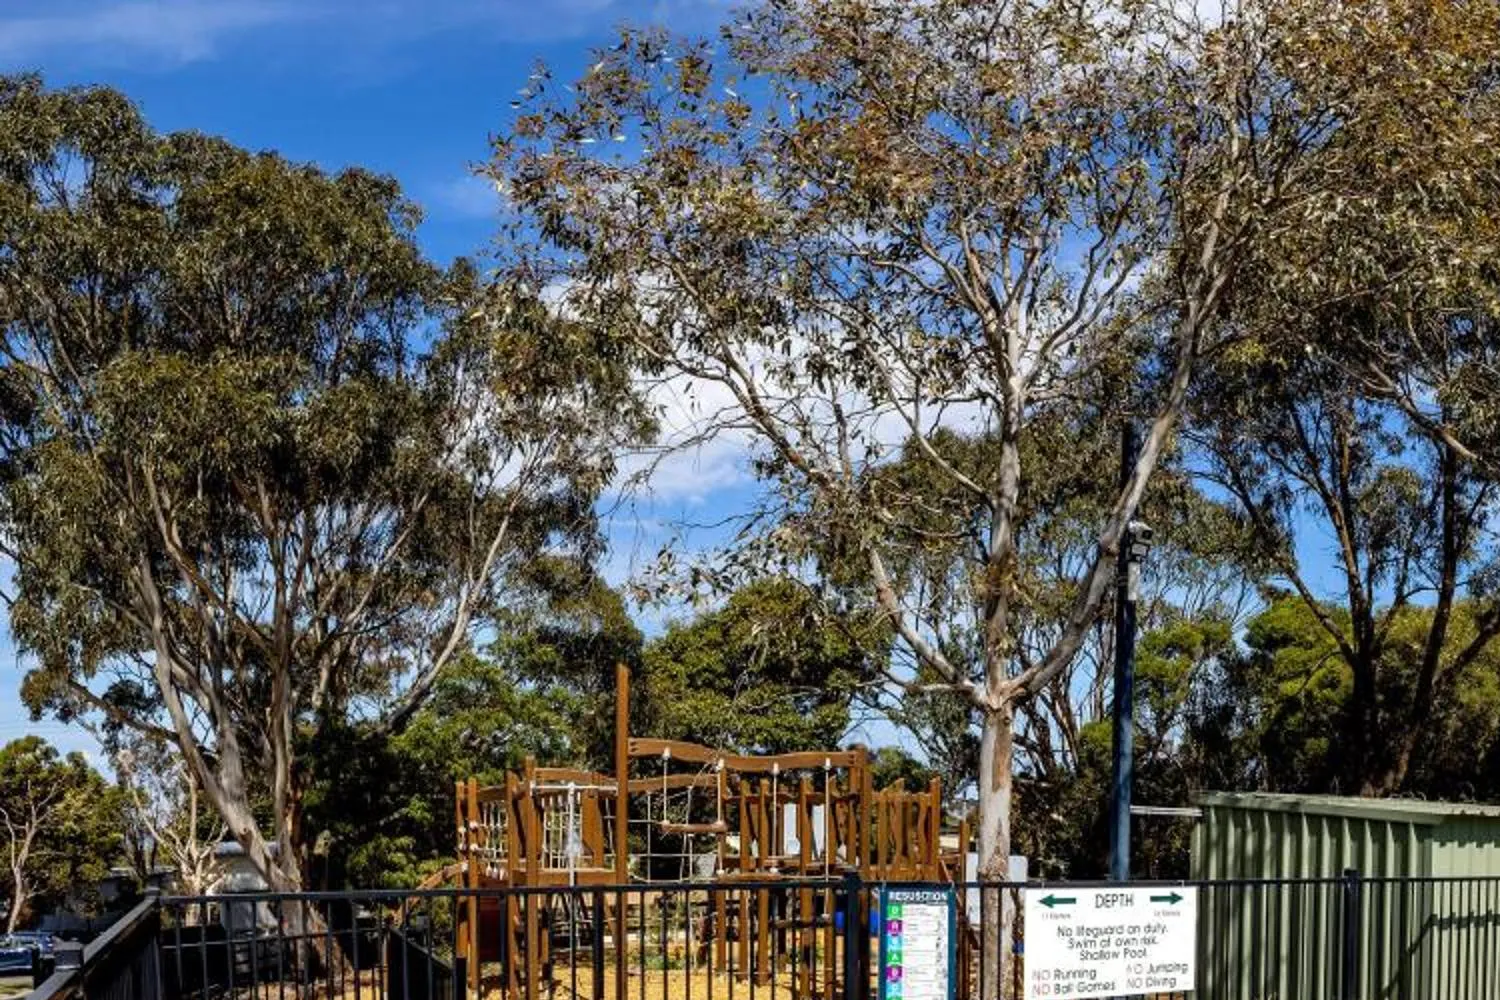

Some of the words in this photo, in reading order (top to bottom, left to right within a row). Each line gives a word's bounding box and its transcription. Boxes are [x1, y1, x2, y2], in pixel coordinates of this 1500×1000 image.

[1095, 893, 1134, 908] DEPTH
[1057, 926, 1072, 937] No
[1075, 923, 1123, 938] lifeguard
[1127, 926, 1140, 935] on
[1067, 937, 1097, 949] Swim
[1115, 937, 1138, 947] own
[1079, 948, 1119, 961] Shallow
[1032, 969, 1051, 981] NO
[1053, 967, 1097, 981] Running
[1146, 961, 1189, 976] Jumping
[1032, 983, 1051, 996] NO
[1054, 982, 1074, 994] Ball
[1077, 980, 1116, 993] Games
[1126, 977, 1143, 989] NO
[1145, 975, 1177, 989] Diving
